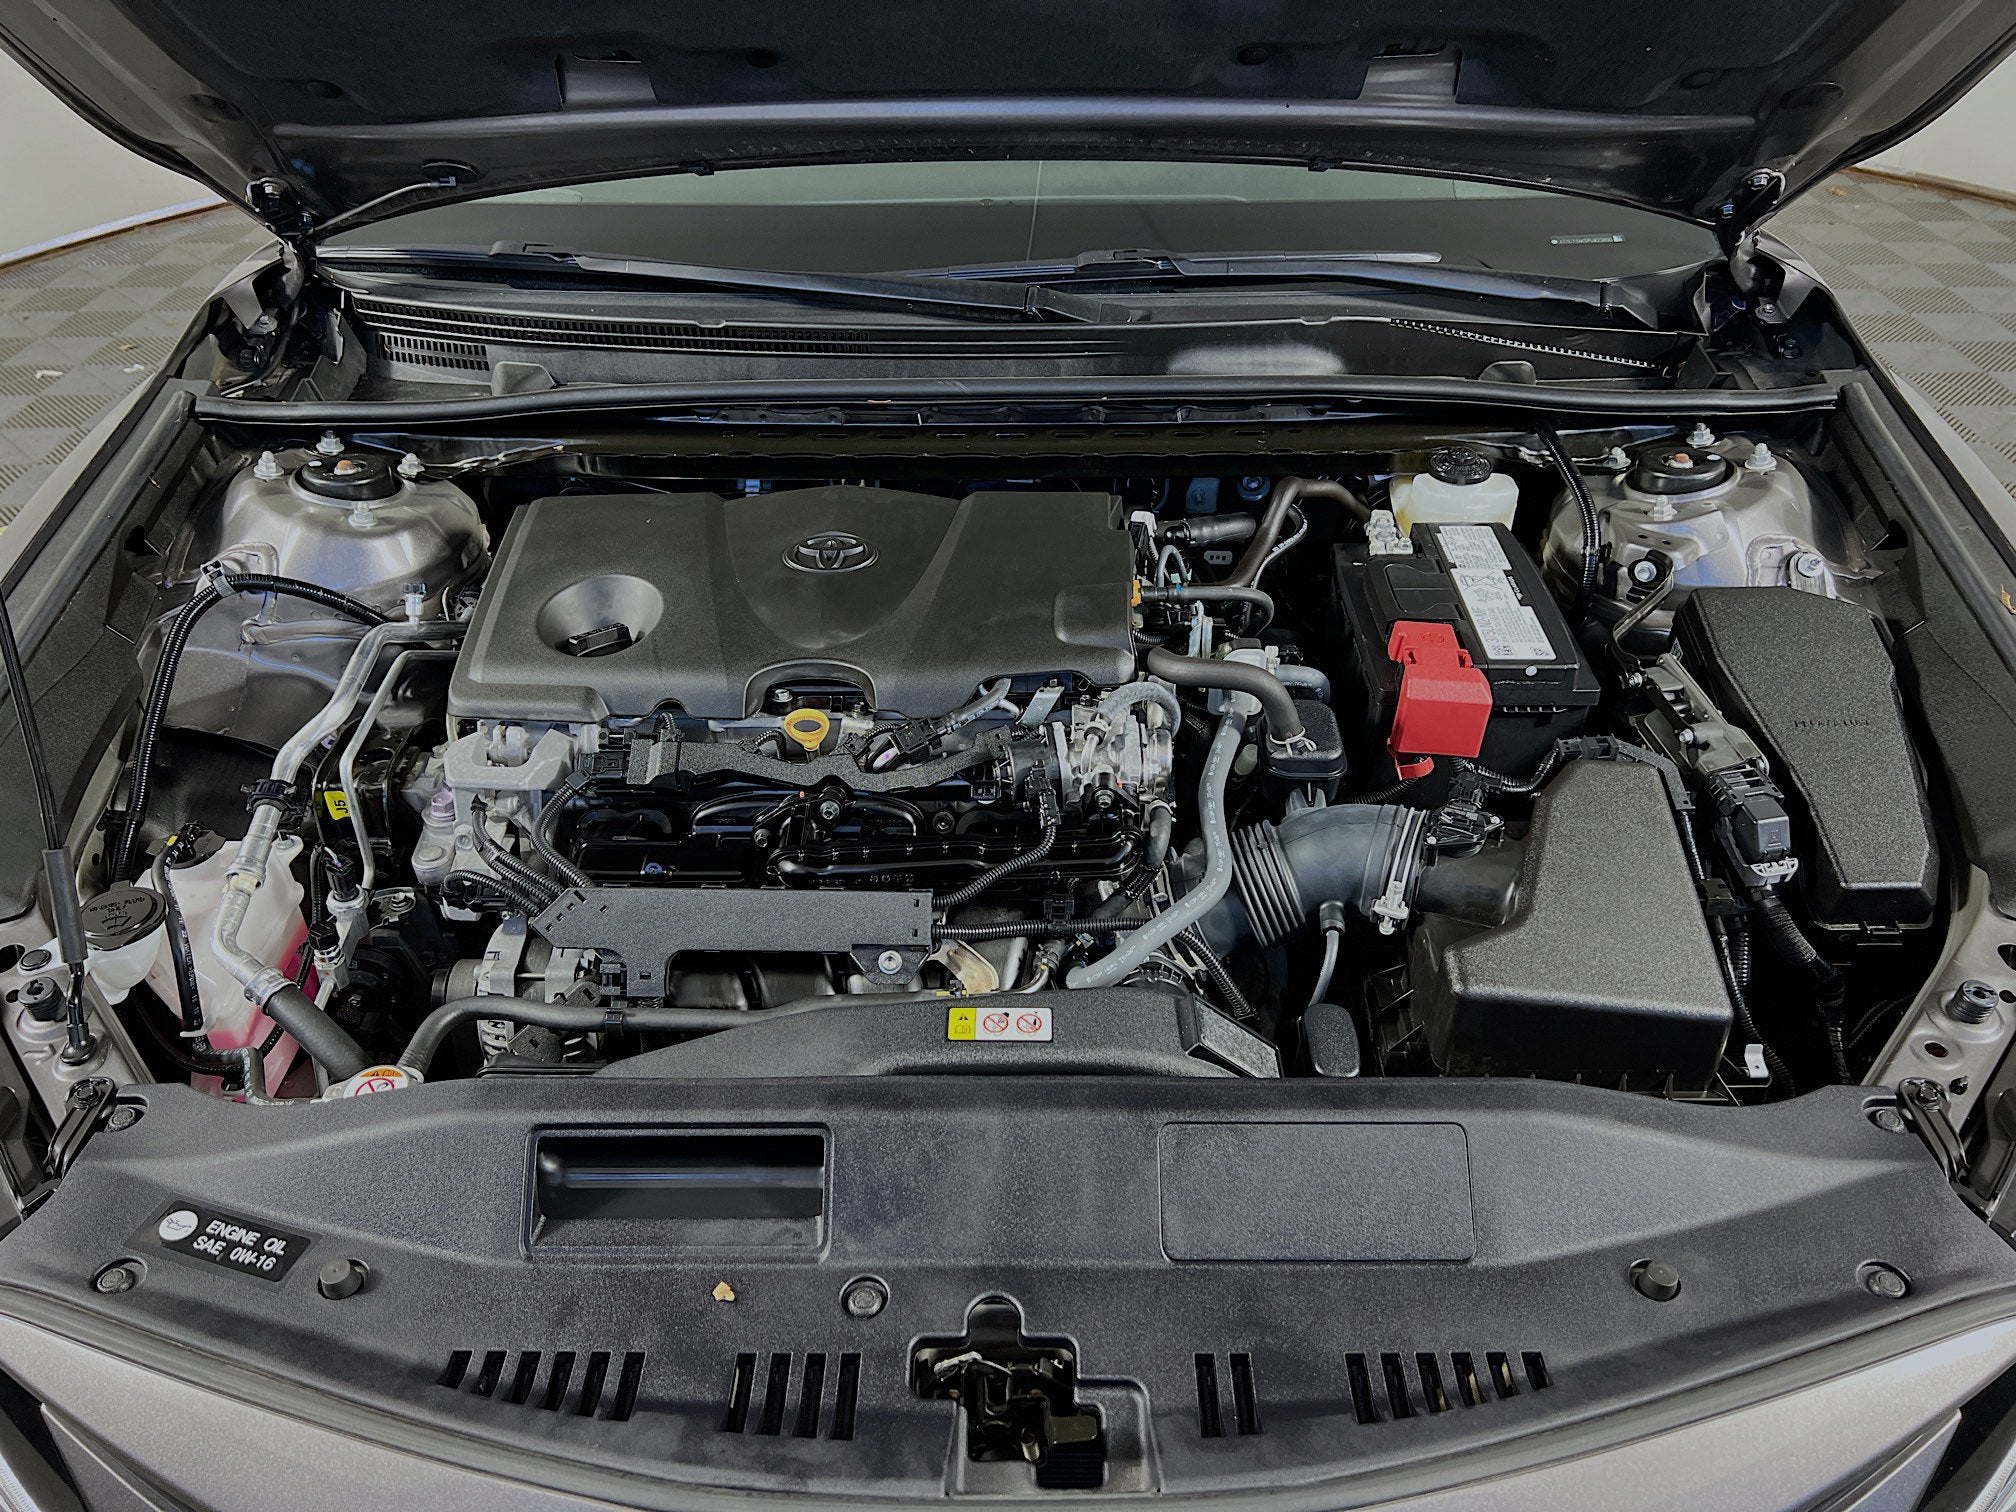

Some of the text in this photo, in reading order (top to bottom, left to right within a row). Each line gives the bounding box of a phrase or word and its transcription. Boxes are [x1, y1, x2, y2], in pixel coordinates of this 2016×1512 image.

[334, 800, 348, 814] J5
[192, 1235, 277, 1272] SAE 0W-16
[205, 1219, 287, 1256] ENGINE OIL
